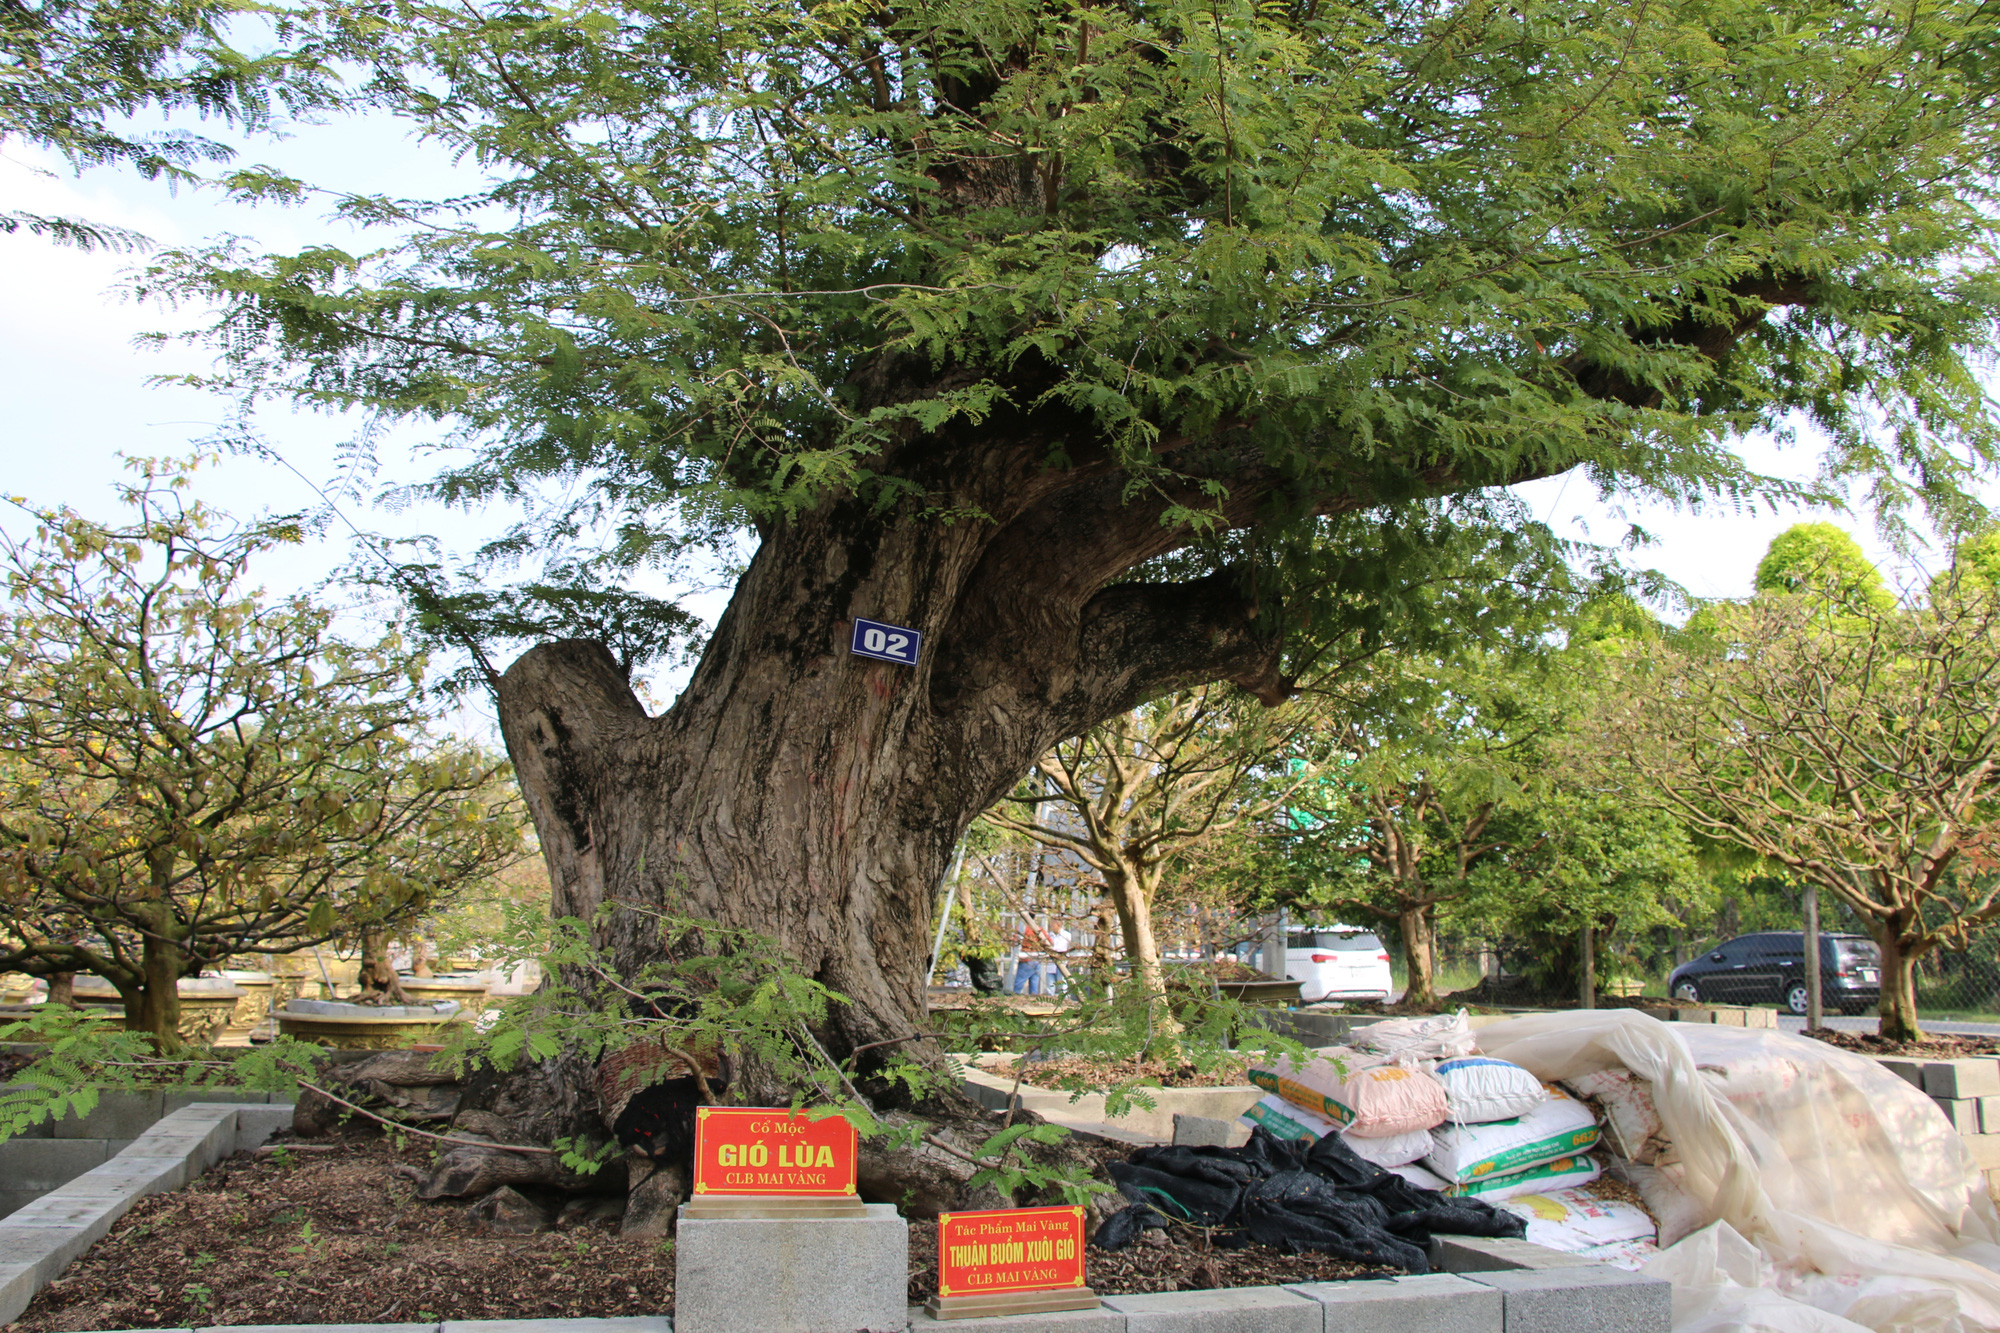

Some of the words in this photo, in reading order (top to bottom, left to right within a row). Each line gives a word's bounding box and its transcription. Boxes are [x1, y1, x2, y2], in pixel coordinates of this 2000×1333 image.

[864, 628, 909, 658] 02
[750, 1120, 771, 1134] Cổ
[774, 1122, 806, 1137] Mộc
[718, 1140, 768, 1167] GIÓ
[778, 1140, 835, 1168] LÙA
[726, 1172, 754, 1185] CLB
[757, 1173, 784, 1185] MAI
[787, 1170, 826, 1185] VÀNG
[955, 1225, 976, 1236] Tác
[979, 1220, 1013, 1235] Phẩm
[1015, 1221, 1037, 1233] Mai
[1039, 1220, 1069, 1232] Vàng
[949, 1240, 987, 1271] THUẬN
[1027, 1235, 1053, 1263] XUÔI
[1056, 1234, 1075, 1260] GIÓ
[967, 1273, 993, 1286] CLB
[996, 1271, 1020, 1284] MAI
[1023, 1267, 1058, 1281] VÀNG
